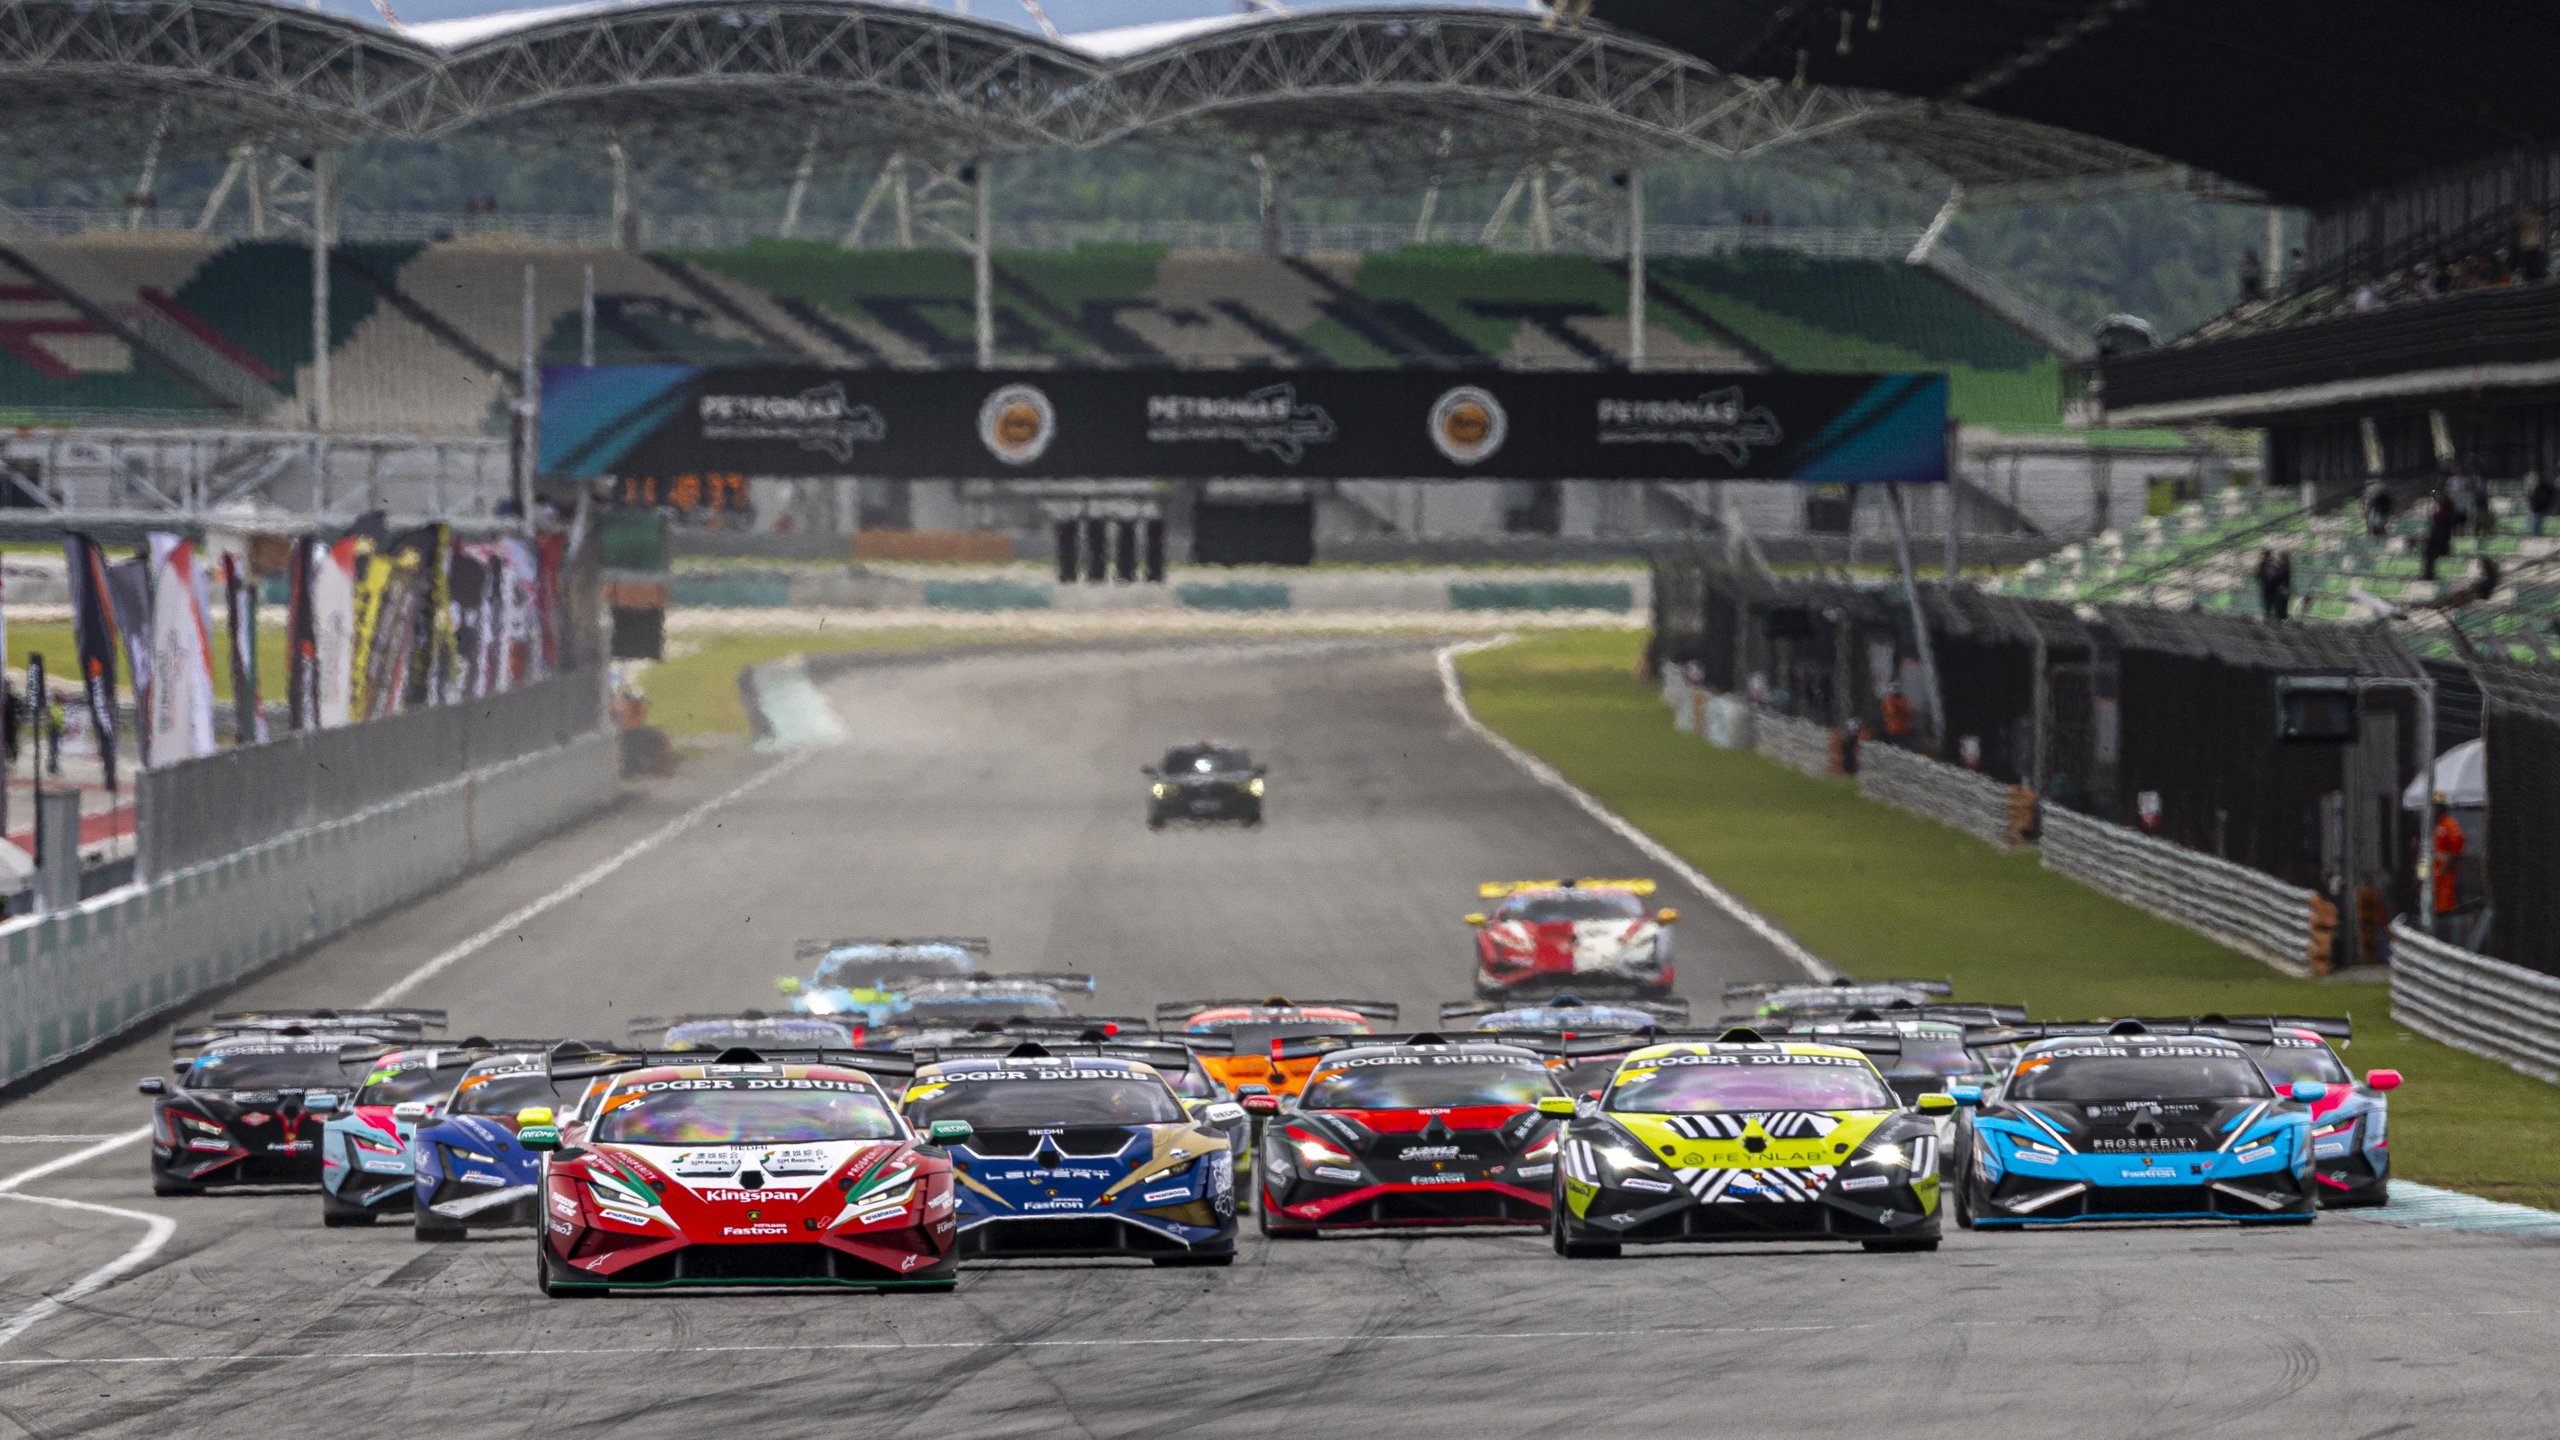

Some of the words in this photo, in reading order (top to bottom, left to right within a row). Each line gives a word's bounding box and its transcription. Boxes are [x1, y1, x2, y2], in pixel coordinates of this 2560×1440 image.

[701, 396, 842, 418] PETRONAS
[1147, 396, 1289, 418] PETRONAS
[1598, 400, 1739, 424] PETRONAS
[2036, 1047, 2129, 1059] ROGER
[2138, 1046, 2240, 1058] DUBUIS
[1331, 1056, 1423, 1069] ROGER
[1432, 1055, 1533, 1065] DUBUIS
[1638, 1055, 1739, 1068] ROGER
[1752, 1054, 1861, 1067] DUBUIS
[479, 1064, 547, 1076] ROGE
[926, 1071, 1028, 1084] ROGER
[1039, 1069, 1149, 1081] DUBUIS
[626, 1080, 735, 1095] ROGER
[747, 1079, 866, 1092] DUBUIS
[522, 1130, 555, 1138] REDMI
[1028, 1128, 1064, 1136] REDMI
[2093, 1137, 2199, 1149] PROSPERITY
[1713, 1152, 1822, 1162] FEYNLAB
[706, 1189, 799, 1203] Kingspan
[1024, 1201, 1084, 1210] Fastron
[723, 1227, 788, 1235] Fastron
